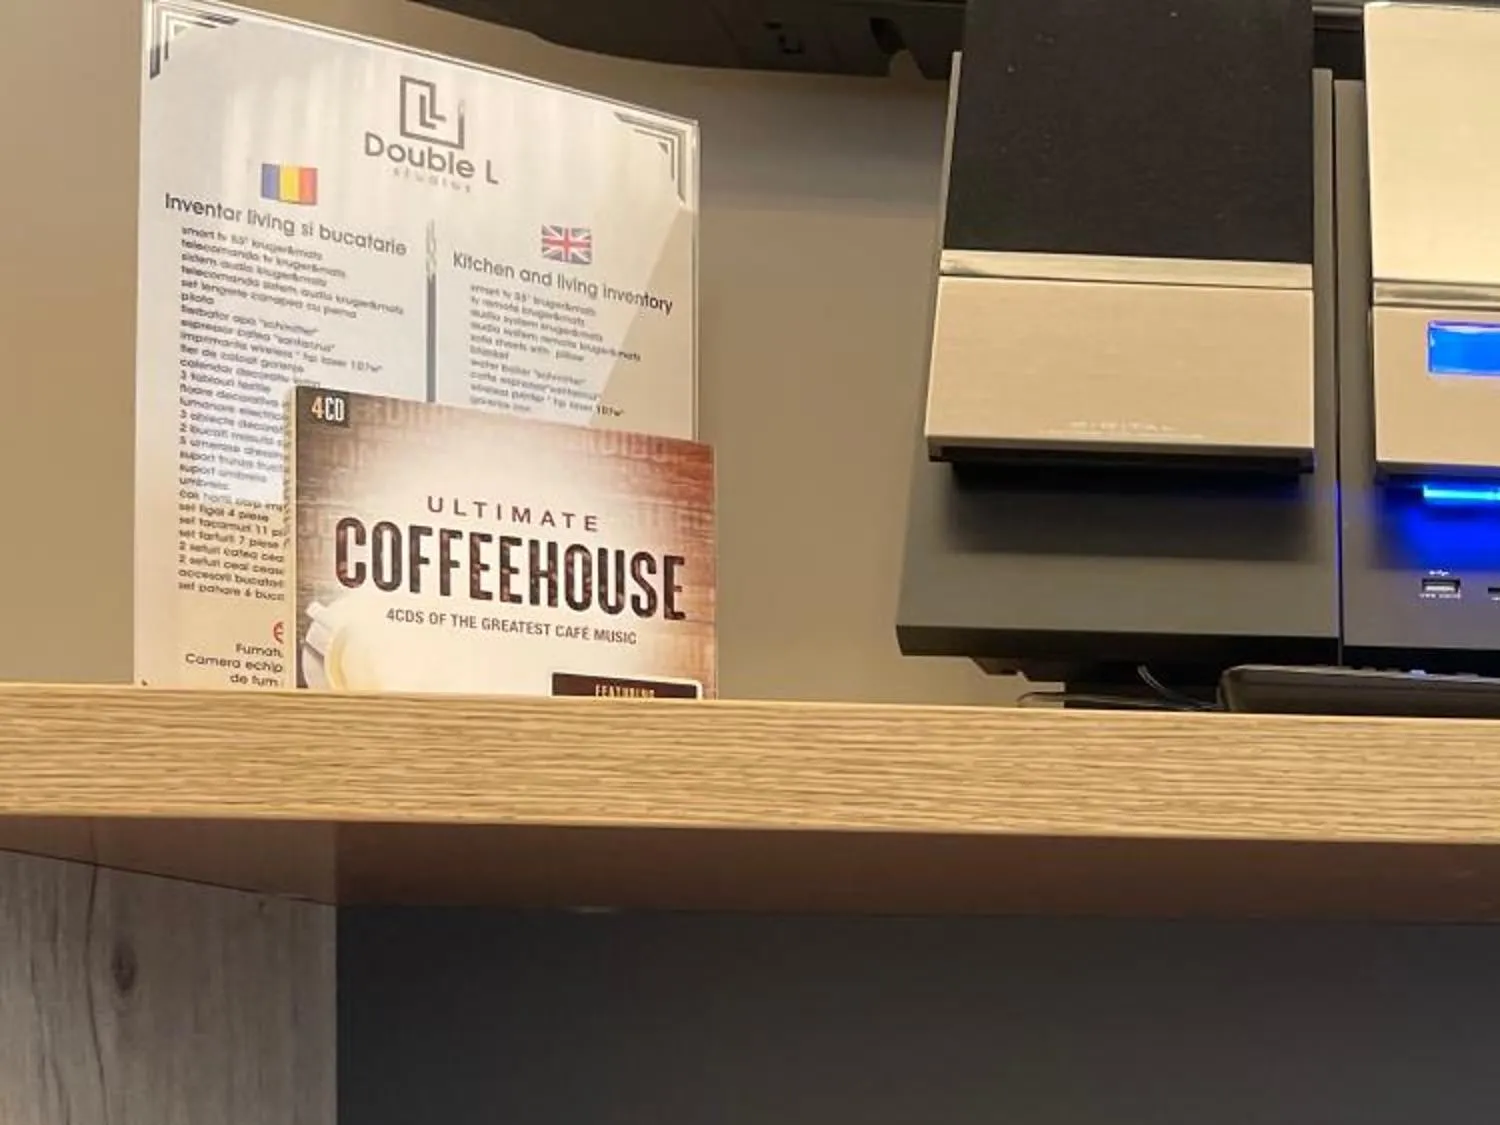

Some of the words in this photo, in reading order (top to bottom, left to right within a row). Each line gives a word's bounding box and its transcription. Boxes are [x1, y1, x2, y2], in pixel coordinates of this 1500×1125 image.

[365, 131, 475, 179] Double
[485, 159, 499, 185] L
[165, 192, 243, 223] Inventar
[247, 208, 295, 237] living
[301, 222, 313, 237] si
[319, 223, 407, 256] bucatarie
[452, 251, 514, 279] Kitchen
[519, 266, 552, 287] and
[557, 273, 598, 299] living
[602, 285, 673, 316] inventory
[311, 396, 345, 422] 4CD
[427, 495, 600, 533] ULTIMATE
[335, 516, 688, 622] COFFEEHOUSE
[386, 608, 425, 626] 4CDS
[428, 612, 448, 628] OF
[451, 613, 478, 631] THE
[481, 617, 552, 638] GREATEST
[594, 629, 638, 645] MUSIC
[185, 653, 241, 669] Camera
[230, 673, 248, 685] de
